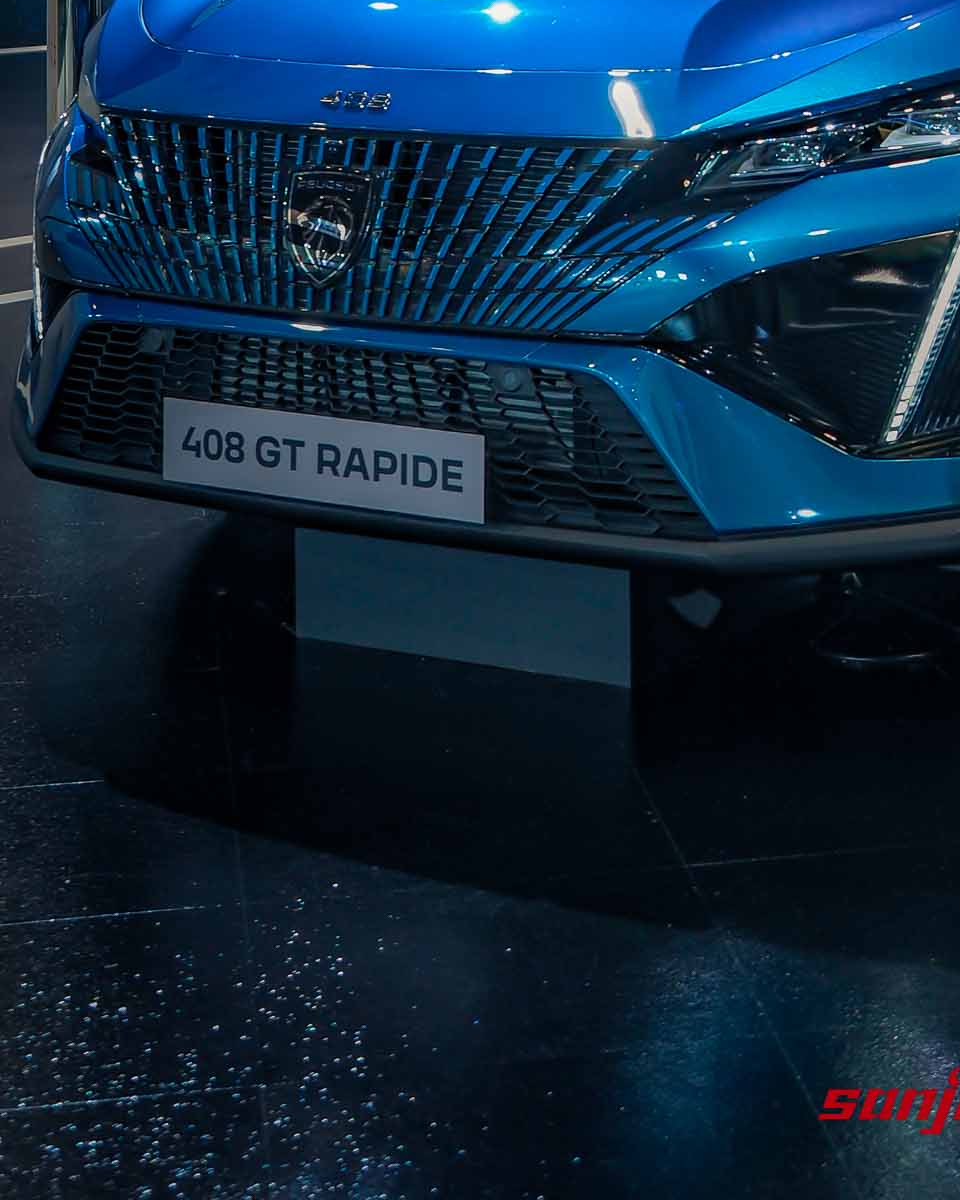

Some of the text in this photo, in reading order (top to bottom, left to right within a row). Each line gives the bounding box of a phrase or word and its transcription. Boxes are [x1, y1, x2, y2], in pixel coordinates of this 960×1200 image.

[181, 426, 463, 493] 408 GT RAPIDE
